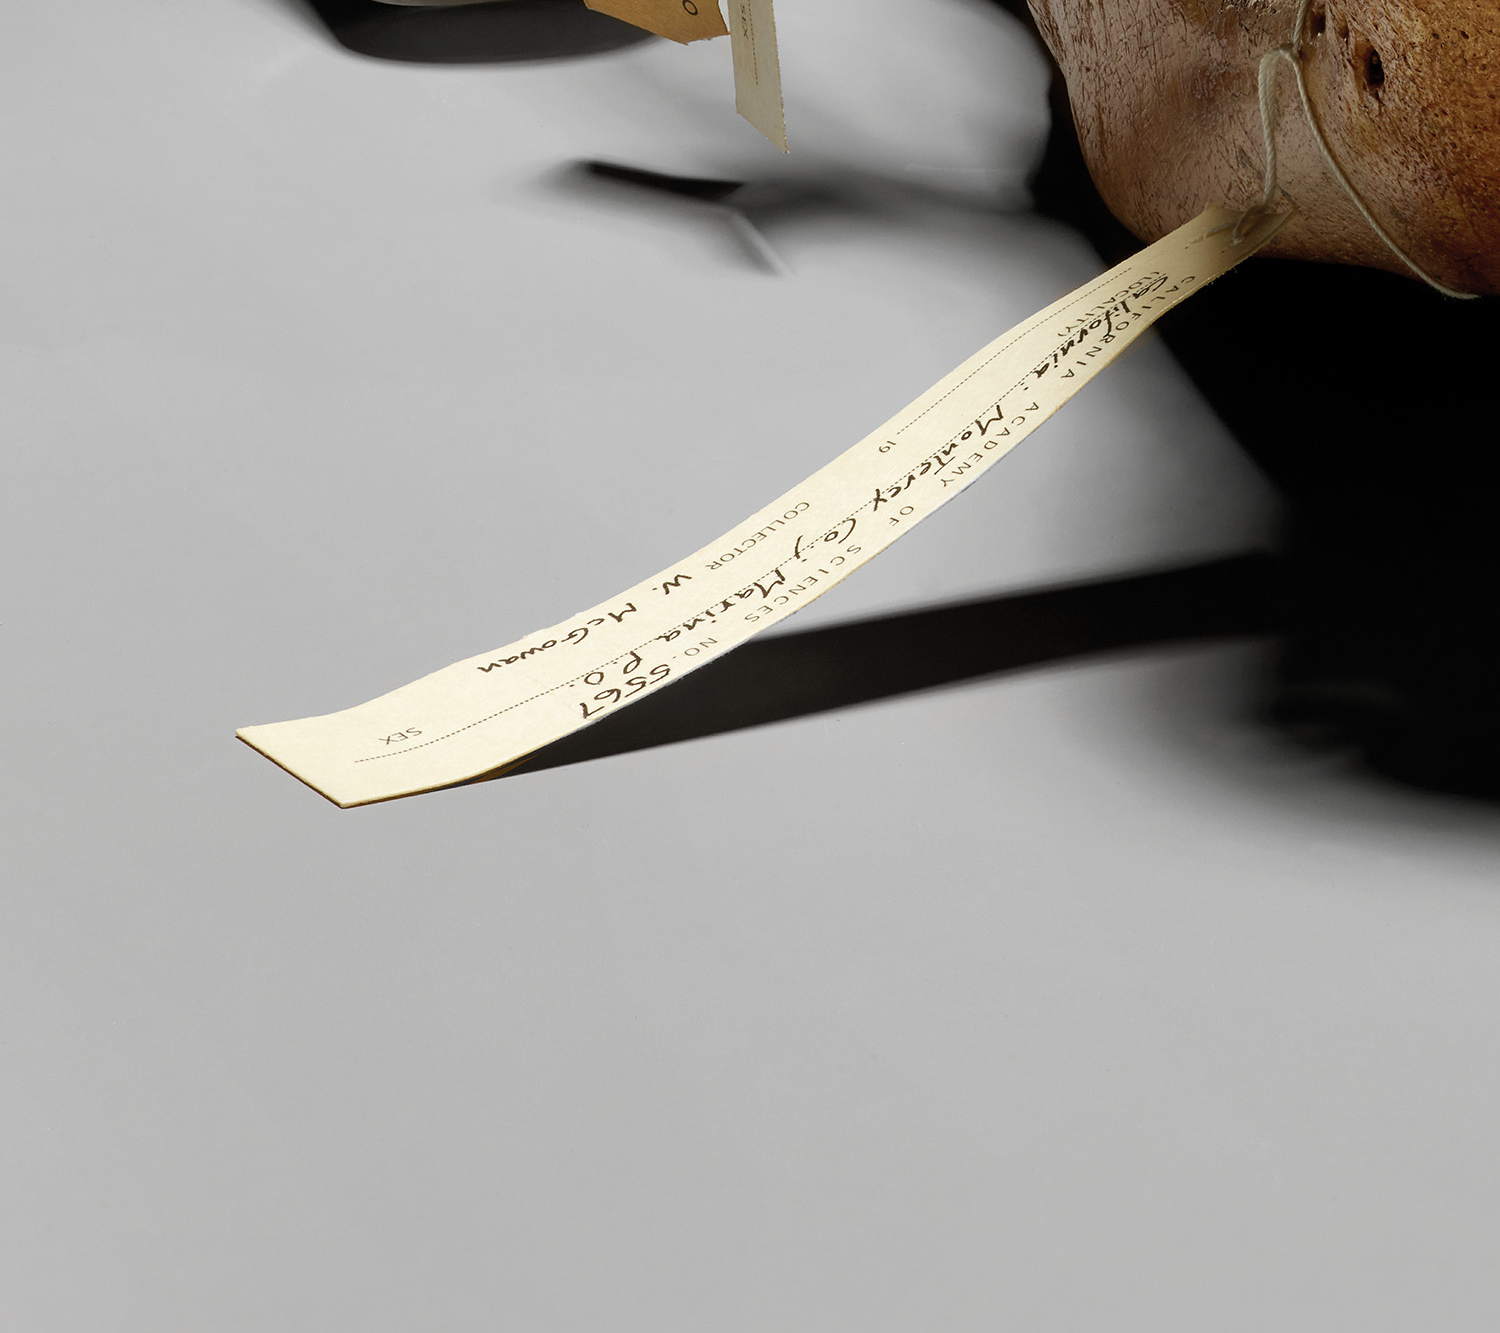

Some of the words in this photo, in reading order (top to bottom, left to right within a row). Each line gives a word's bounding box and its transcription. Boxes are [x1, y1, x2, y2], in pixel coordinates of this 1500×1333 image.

[739, 3, 749, 41] SEX
[1057, 271, 1161, 338] (LOCALITY)
[1059, 275, 1196, 381] CALIFORNIA
[872, 403, 1005, 513] Monterey
[877, 439, 897, 454] 19
[940, 401, 1041, 488] ACADEMY
[705, 501, 811, 571] COLLECTOR
[887, 505, 915, 527] OF
[651, 573, 693, 596] W.
[654, 569, 786, 643] Marina
[743, 544, 862, 623] SCIENCES
[477, 601, 638, 674] McGowan
[671, 637, 718, 661] NO.
[579, 663, 671, 720] 5567
[377, 726, 423, 746] SEX
